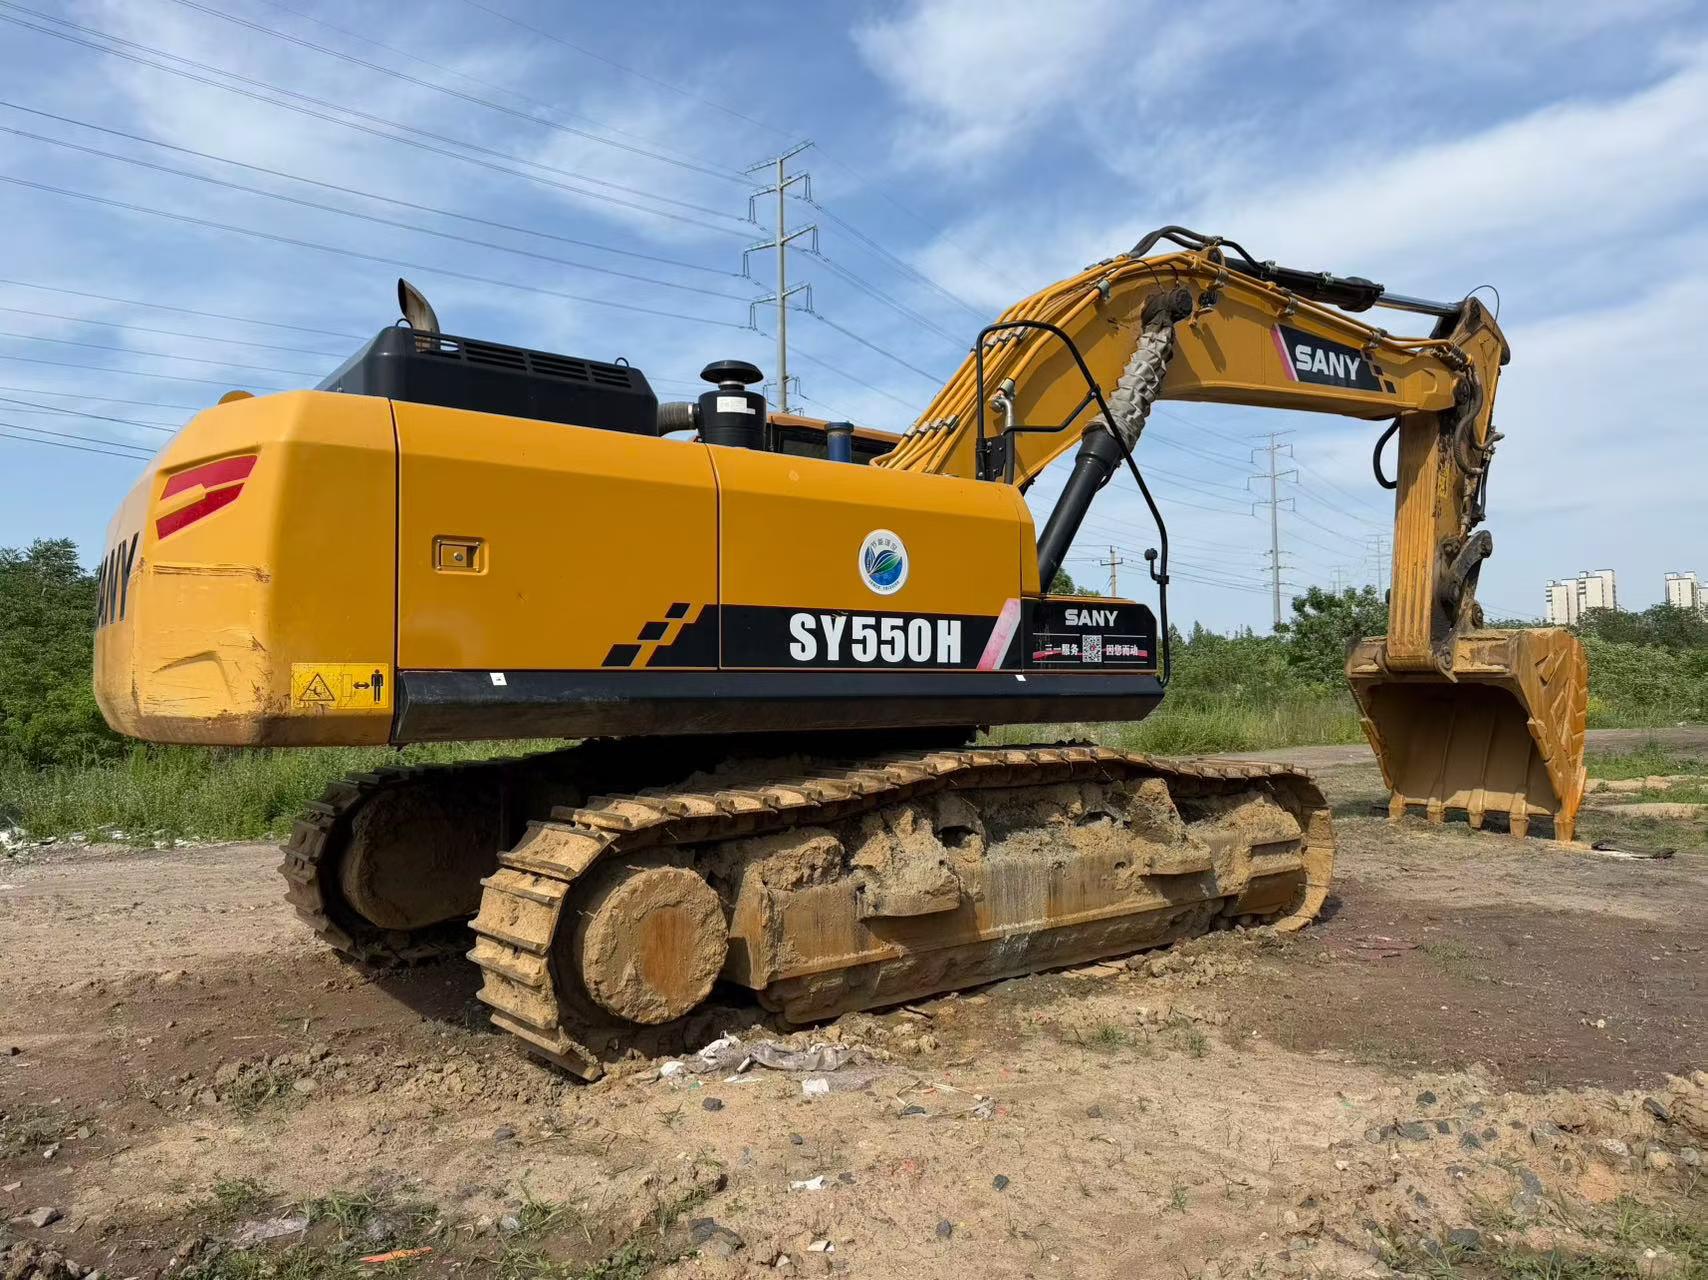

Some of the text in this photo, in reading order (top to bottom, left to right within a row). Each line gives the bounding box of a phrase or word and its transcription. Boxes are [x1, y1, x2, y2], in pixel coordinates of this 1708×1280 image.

[1295, 344, 1361, 380] SANY
[1065, 608, 1118, 627] SANY
[789, 612, 962, 664] SY550H
[1044, 643, 1079, 656] 三一服务
[1106, 644, 1138, 656] 因您而动
